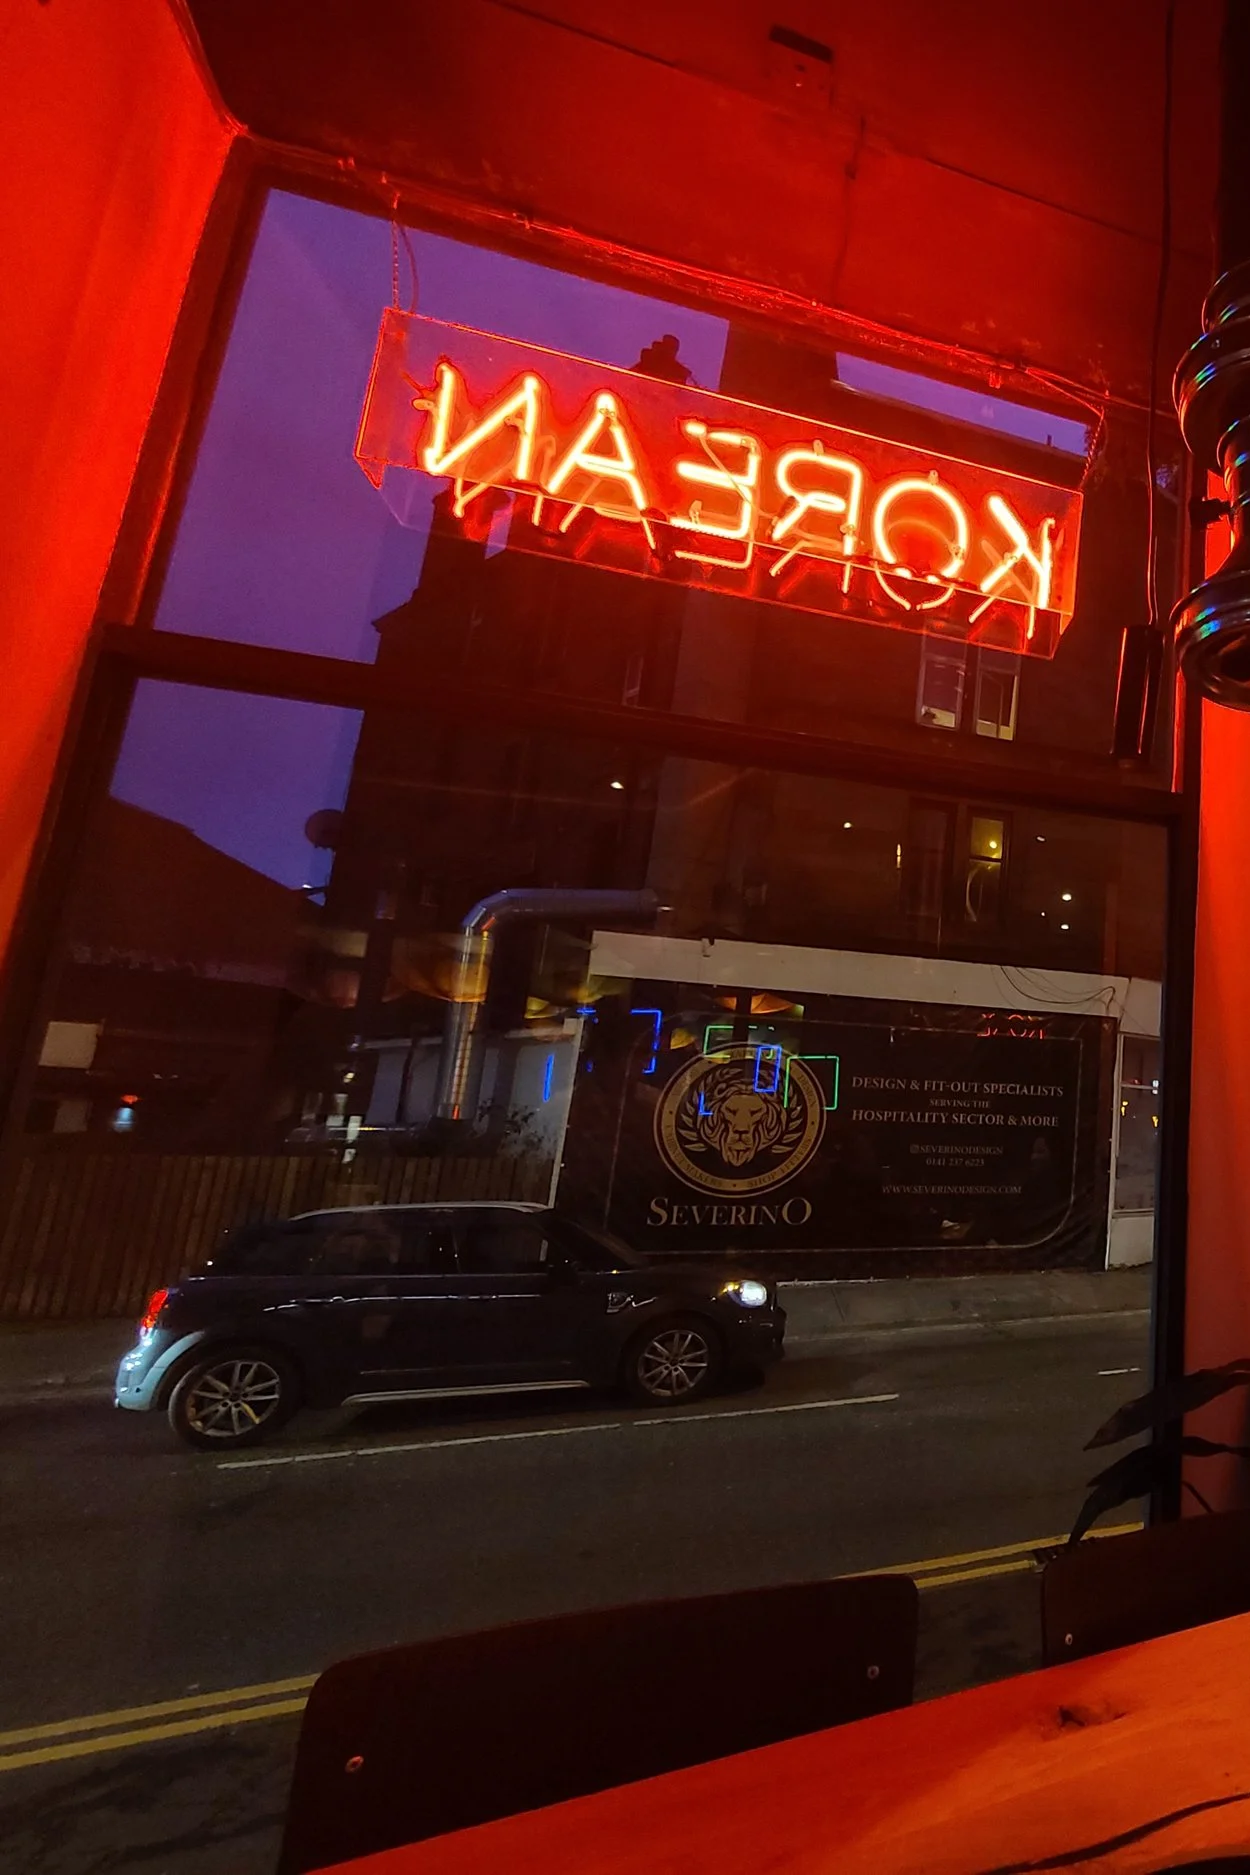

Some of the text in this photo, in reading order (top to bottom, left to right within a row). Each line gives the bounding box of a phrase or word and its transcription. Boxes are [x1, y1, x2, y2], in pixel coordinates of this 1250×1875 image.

[851, 1076, 1064, 1097] DESIGN & FIT-OUT SPECIALISTS
[851, 1109, 1060, 1127] HOSPITALITY SECTOR & MORE
[646, 1197, 812, 1226] SEVERINO
